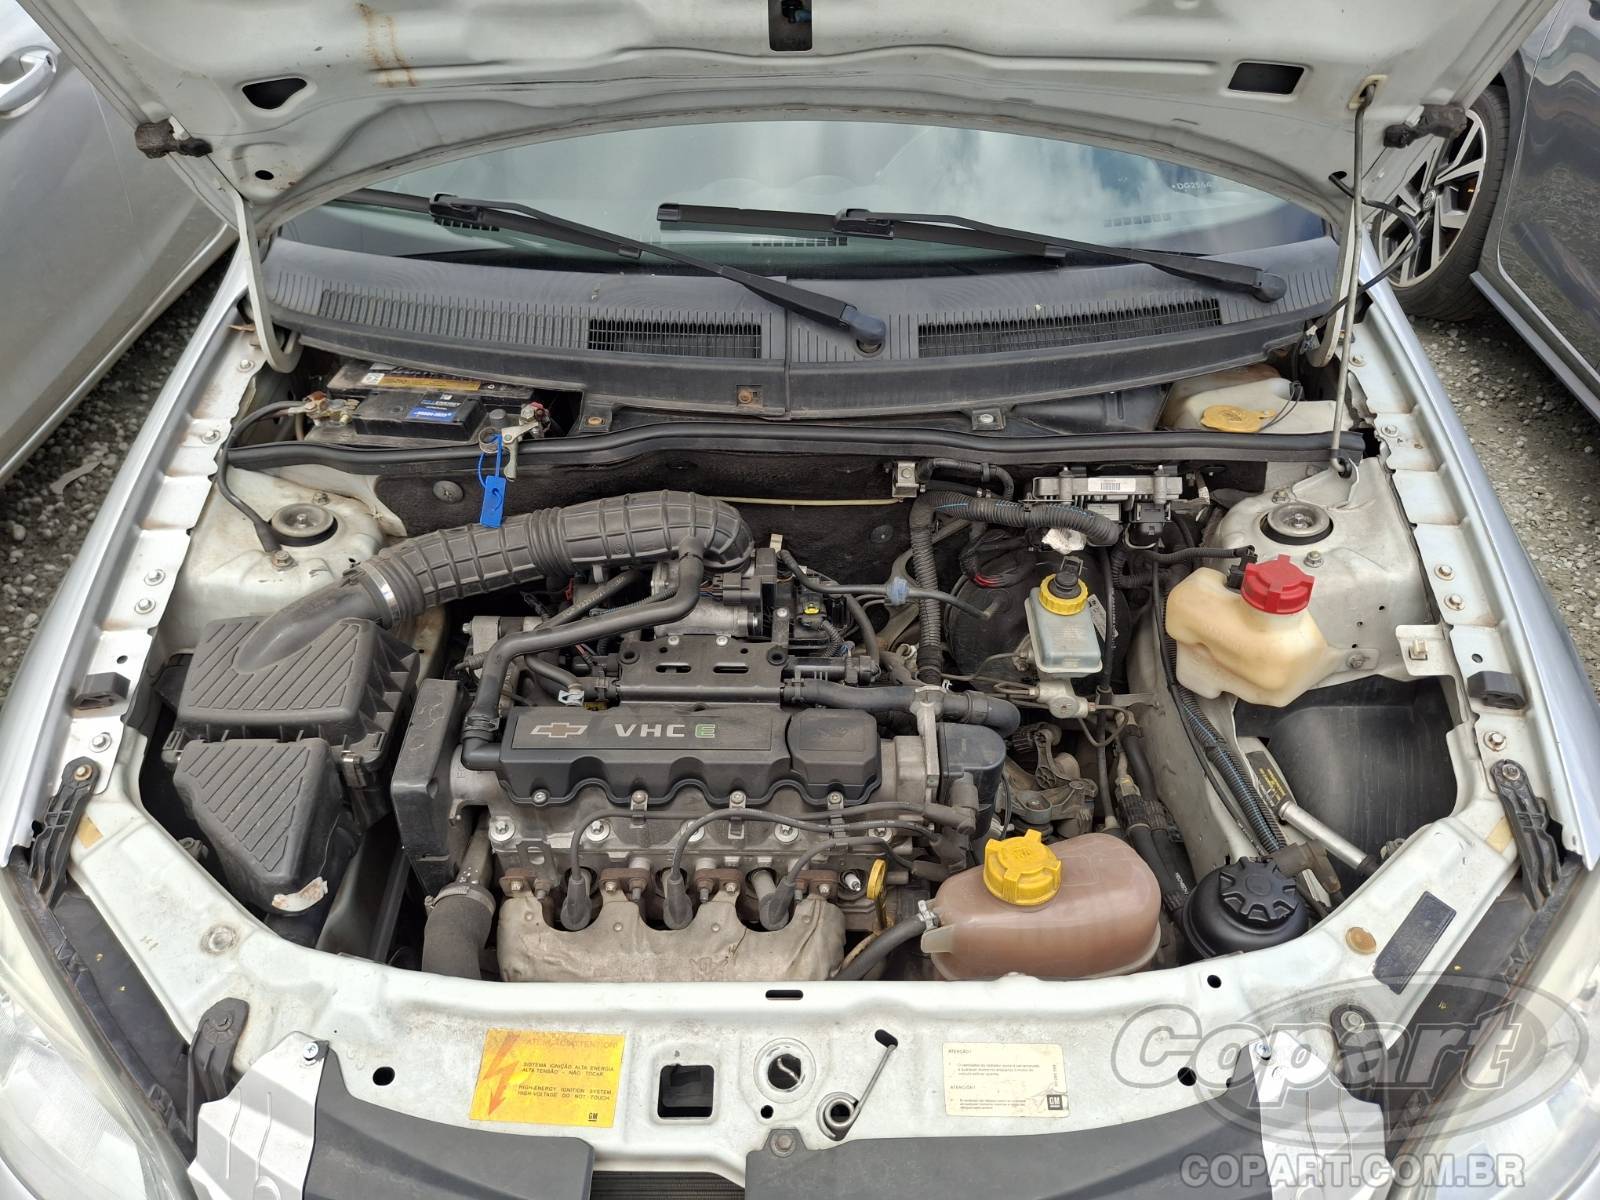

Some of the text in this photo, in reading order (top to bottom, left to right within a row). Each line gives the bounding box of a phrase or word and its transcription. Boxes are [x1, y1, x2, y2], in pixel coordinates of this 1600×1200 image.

[614, 724, 716, 738] VHC E
[588, 1112, 598, 1120] GM
